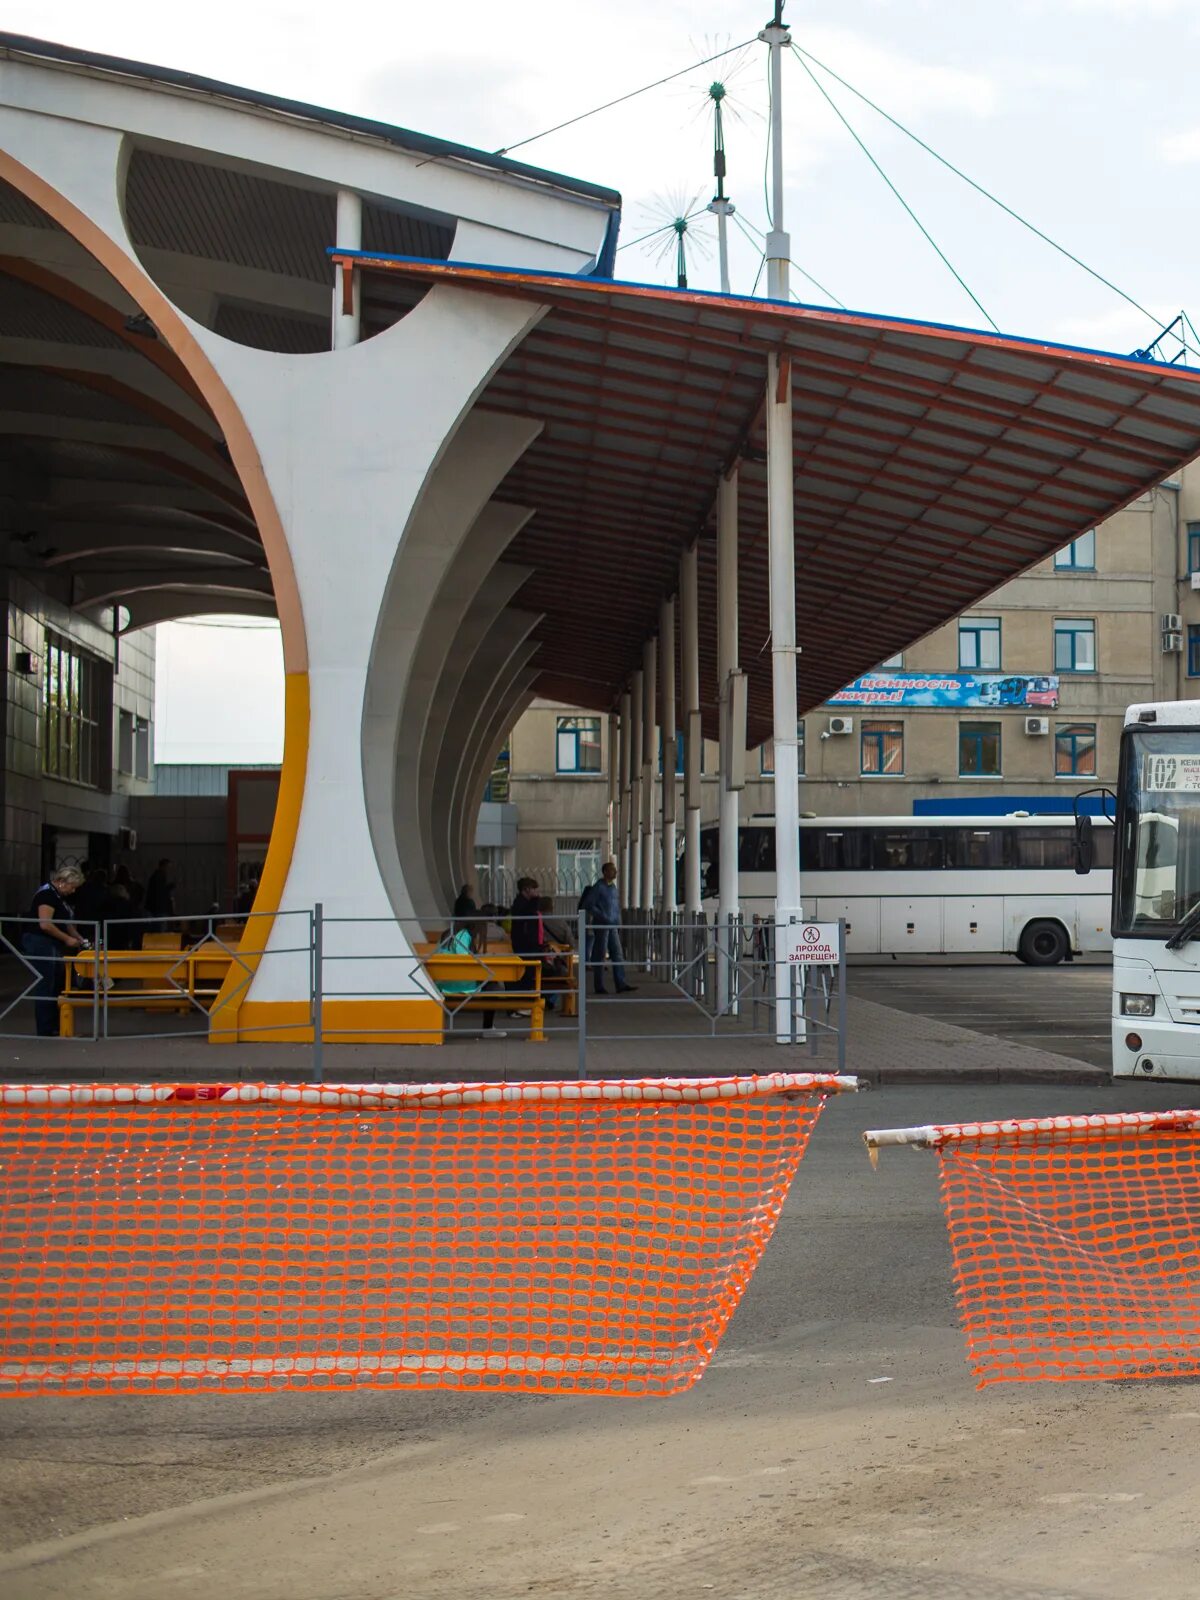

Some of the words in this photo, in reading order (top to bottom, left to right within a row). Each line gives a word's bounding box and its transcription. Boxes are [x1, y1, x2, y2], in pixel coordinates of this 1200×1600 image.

[861, 679, 961, 690] ценность
[831, 690, 905, 703] жиры!
[1147, 757, 1177, 789] 102
[796, 944, 831, 952] ПРОХОД
[789, 953, 837, 961] ЗАПРЕЩЕН!
